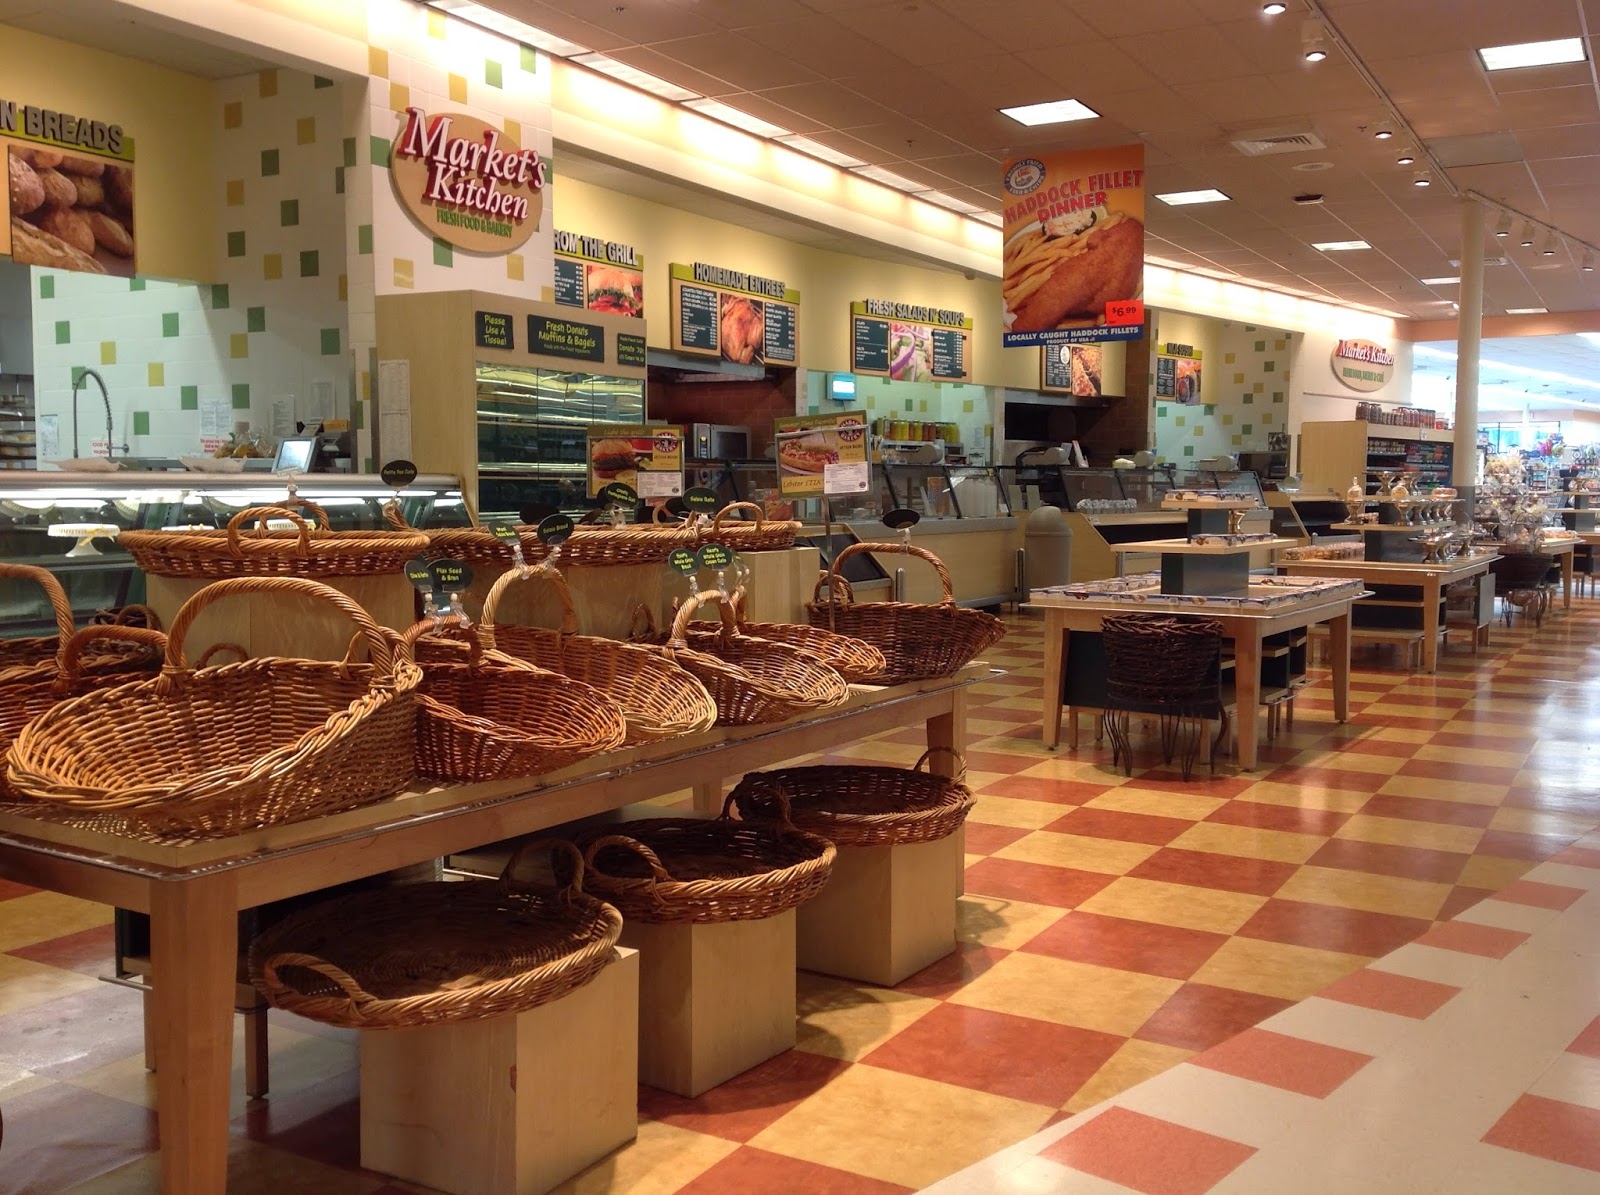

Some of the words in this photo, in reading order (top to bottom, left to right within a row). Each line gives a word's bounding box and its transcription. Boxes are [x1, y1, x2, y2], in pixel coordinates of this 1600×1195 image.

[24, 105, 124, 154] BREADS
[398, 107, 547, 189] Market's
[426, 162, 529, 219] Kitchen
[1003, 178, 1081, 224] HADDOCK
[1088, 169, 1144, 192] FILLET
[1036, 191, 1108, 224] DINNER
[437, 208, 460, 227] FRESH
[460, 214, 480, 231] FOOD
[486, 219, 513, 238] BAKERY
[554, 229, 577, 254] ROM
[580, 235, 604, 259] THE
[606, 241, 638, 266] GRILL
[694, 262, 748, 290] HOMEMADE
[748, 274, 785, 299] ENTREES
[484, 314, 506, 326] Please
[866, 298, 895, 316] FRESH
[895, 302, 927, 321] SALADS
[938, 309, 964, 326] SOUPS
[484, 334, 507, 346] Tissue!
[485, 326, 499, 335] Use
[500, 327, 506, 335] A
[538, 330, 565, 344] Muffins
[567, 335, 573, 345] &
[574, 336, 596, 349] Bagels
[546, 321, 565, 332] Fresh
[566, 324, 588, 336] Donuts
[1007, 333, 1038, 342] LOCALLY
[1039, 330, 1069, 339] CAUGHT
[1070, 327, 1109, 337] HADDOCK
[1110, 326, 1139, 335] FILLETS
[840, 431, 861, 442] BAKERY
[782, 480, 803, 488] Lobster
